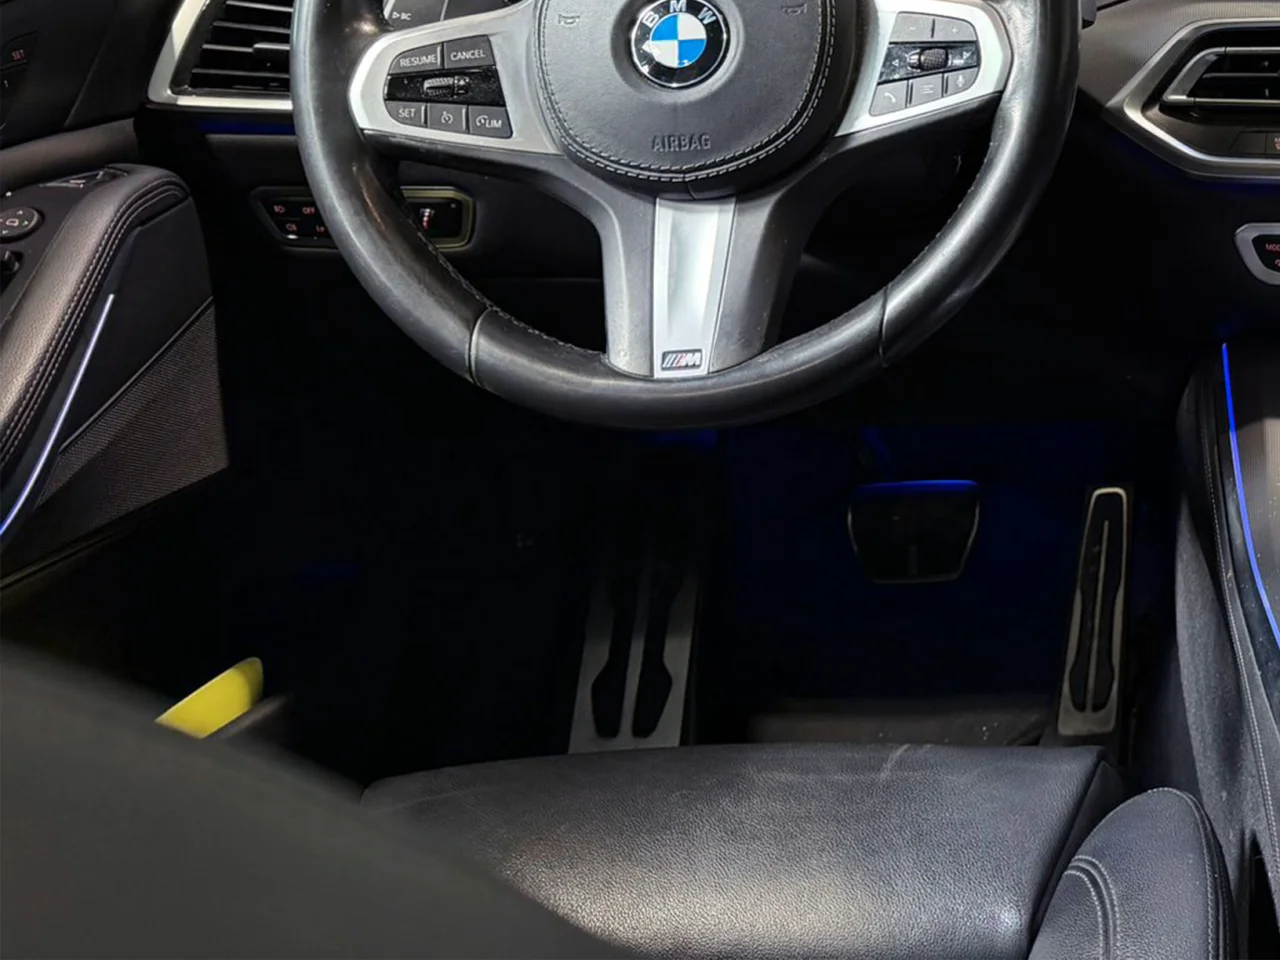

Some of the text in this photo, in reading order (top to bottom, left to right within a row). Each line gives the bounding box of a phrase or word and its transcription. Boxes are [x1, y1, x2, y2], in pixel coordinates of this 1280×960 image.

[642, 0, 717, 29] BMW
[399, 54, 437, 68] RESUME
[450, 48, 486, 61] CANCEL
[398, 108, 416, 118] SET
[485, 119, 502, 129] LIM
[651, 134, 711, 153] AIRBAG
